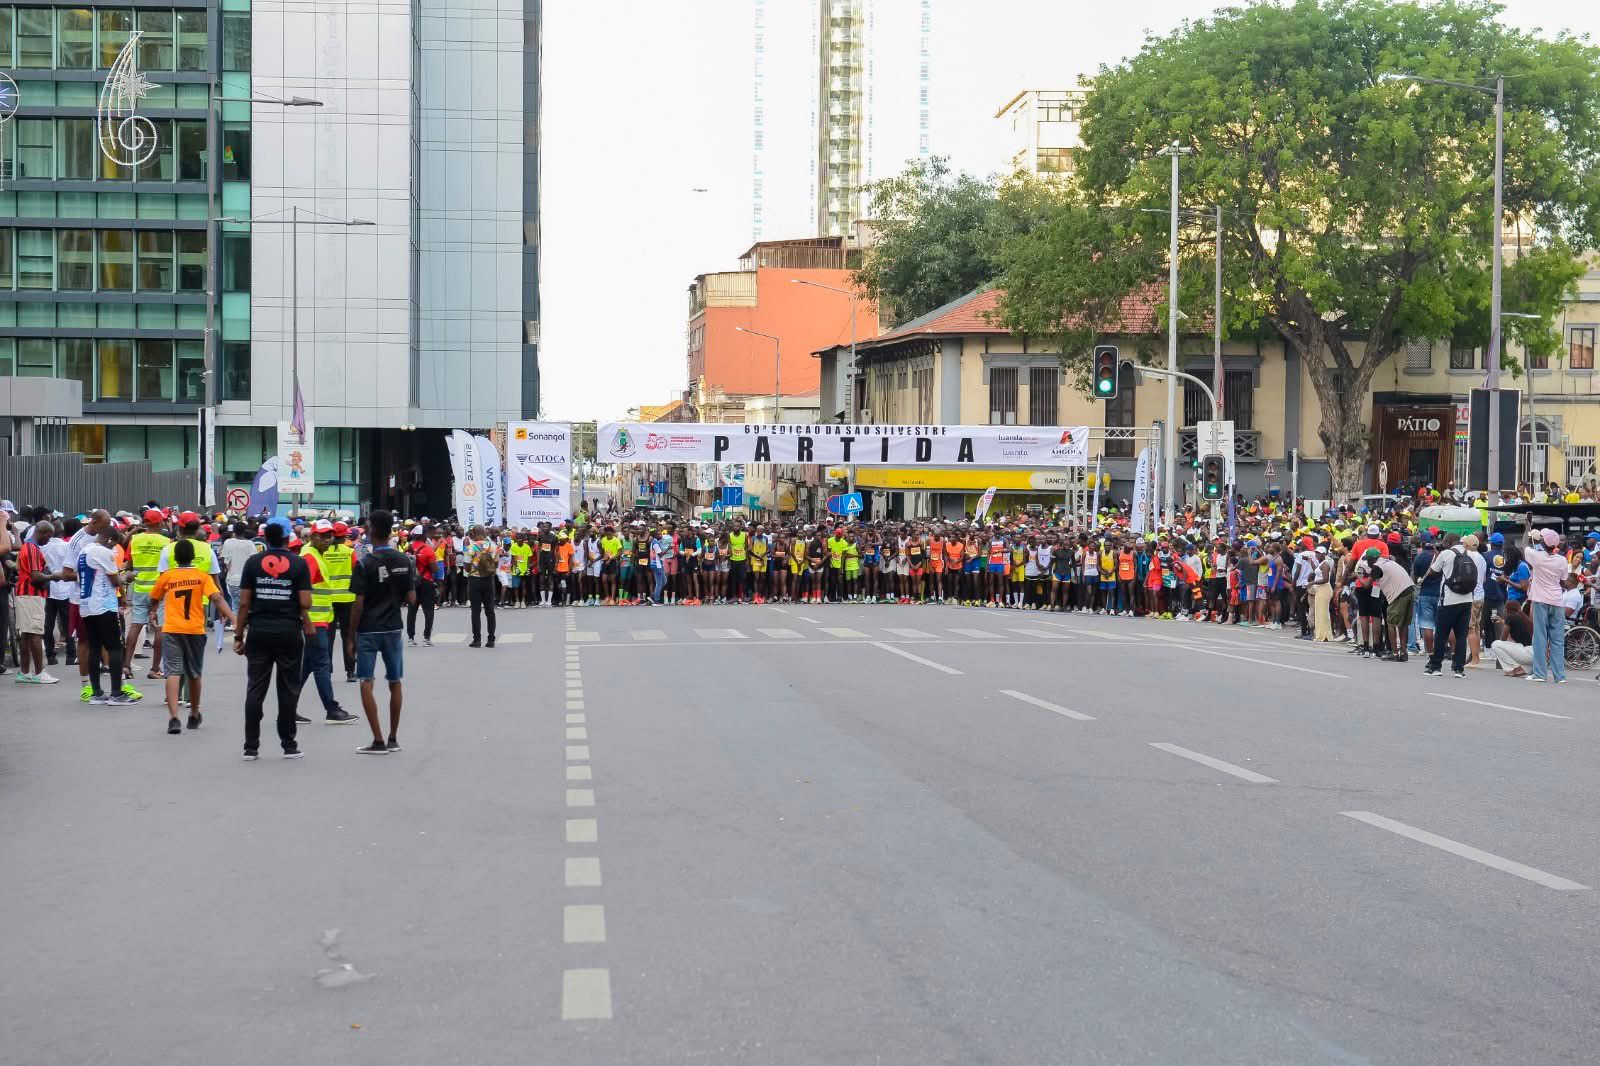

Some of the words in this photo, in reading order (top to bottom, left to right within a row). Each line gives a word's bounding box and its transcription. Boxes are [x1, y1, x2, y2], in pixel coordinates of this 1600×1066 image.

[1397, 415, 1441, 431] PÁTIO
[528, 432, 565, 442] Sonangol
[875, 426, 947, 435] SILVESTRE
[714, 435, 974, 463] PARTIDA
[528, 454, 566, 463] CATOCA
[174, 588, 193, 621] 7
